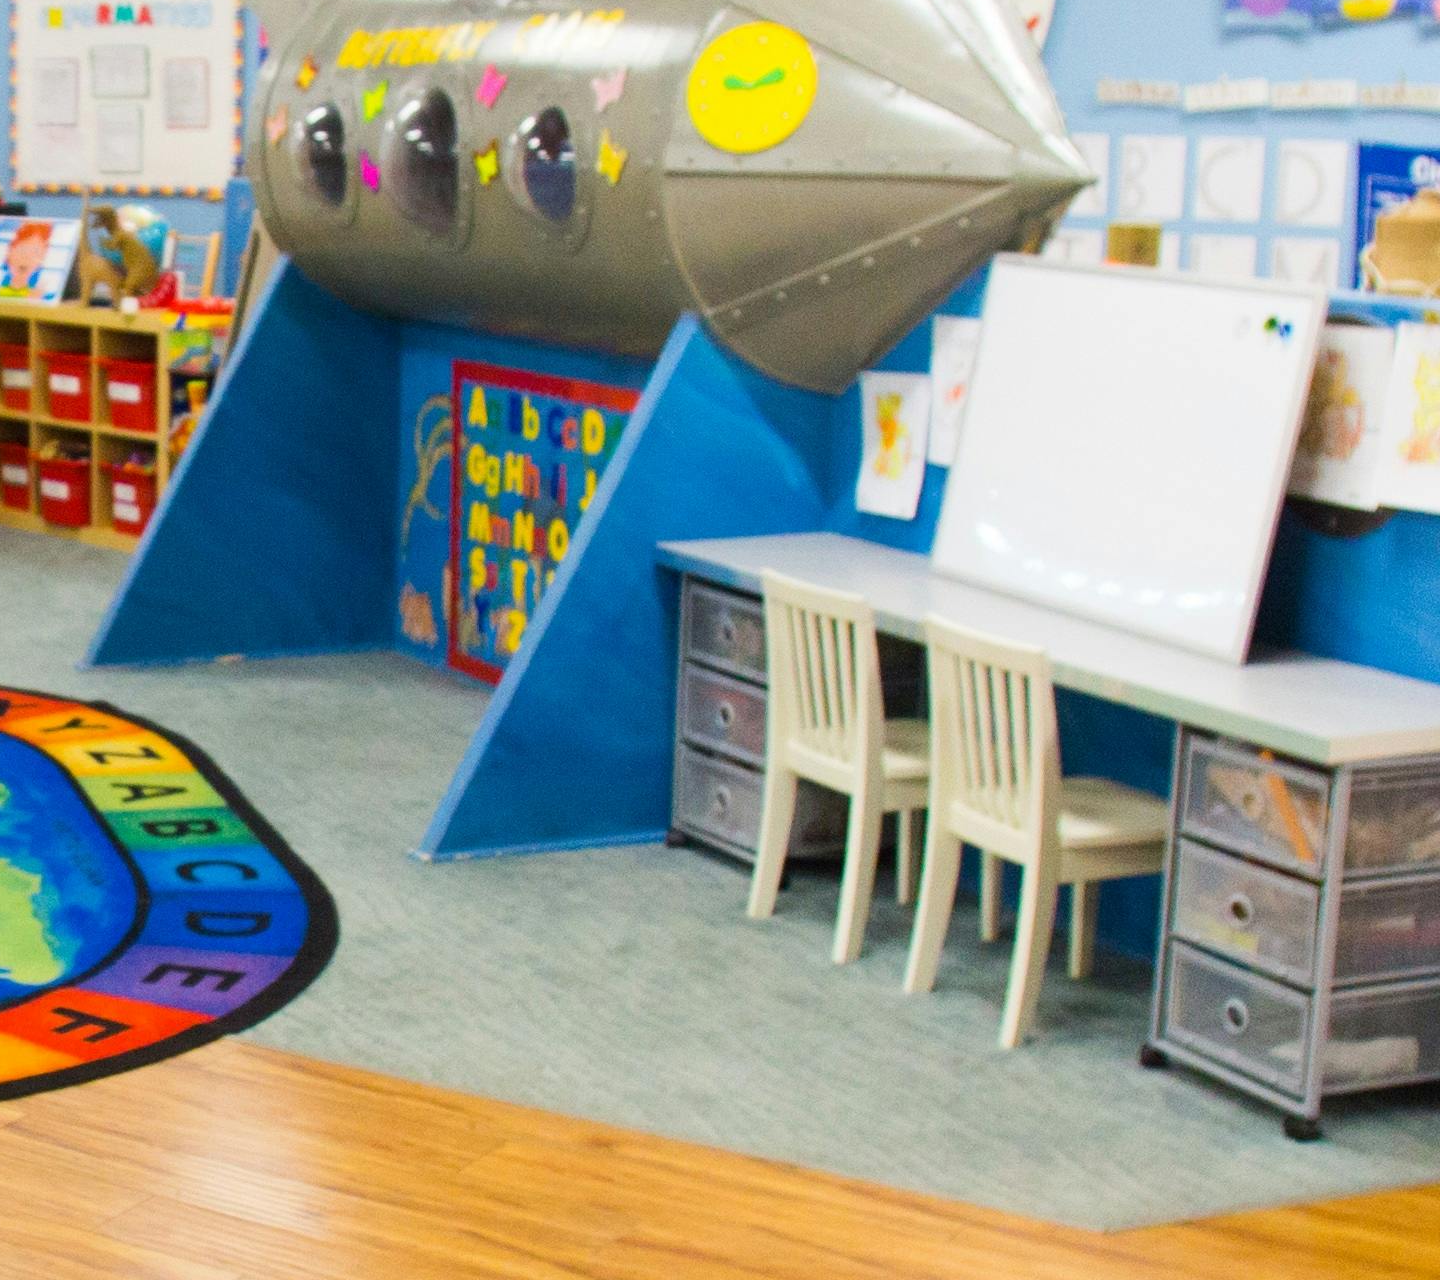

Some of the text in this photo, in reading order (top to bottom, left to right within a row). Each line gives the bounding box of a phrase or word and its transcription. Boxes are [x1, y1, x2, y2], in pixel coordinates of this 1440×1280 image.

[40, 717, 110, 734] Y
[85, 745, 163, 766] Z
[109, 781, 187, 804] A
[138, 818, 219, 839] B
[175, 859, 259, 884] C
[183, 910, 273, 938] D
[141, 962, 247, 993] E
[50, 1006, 133, 1044] F
